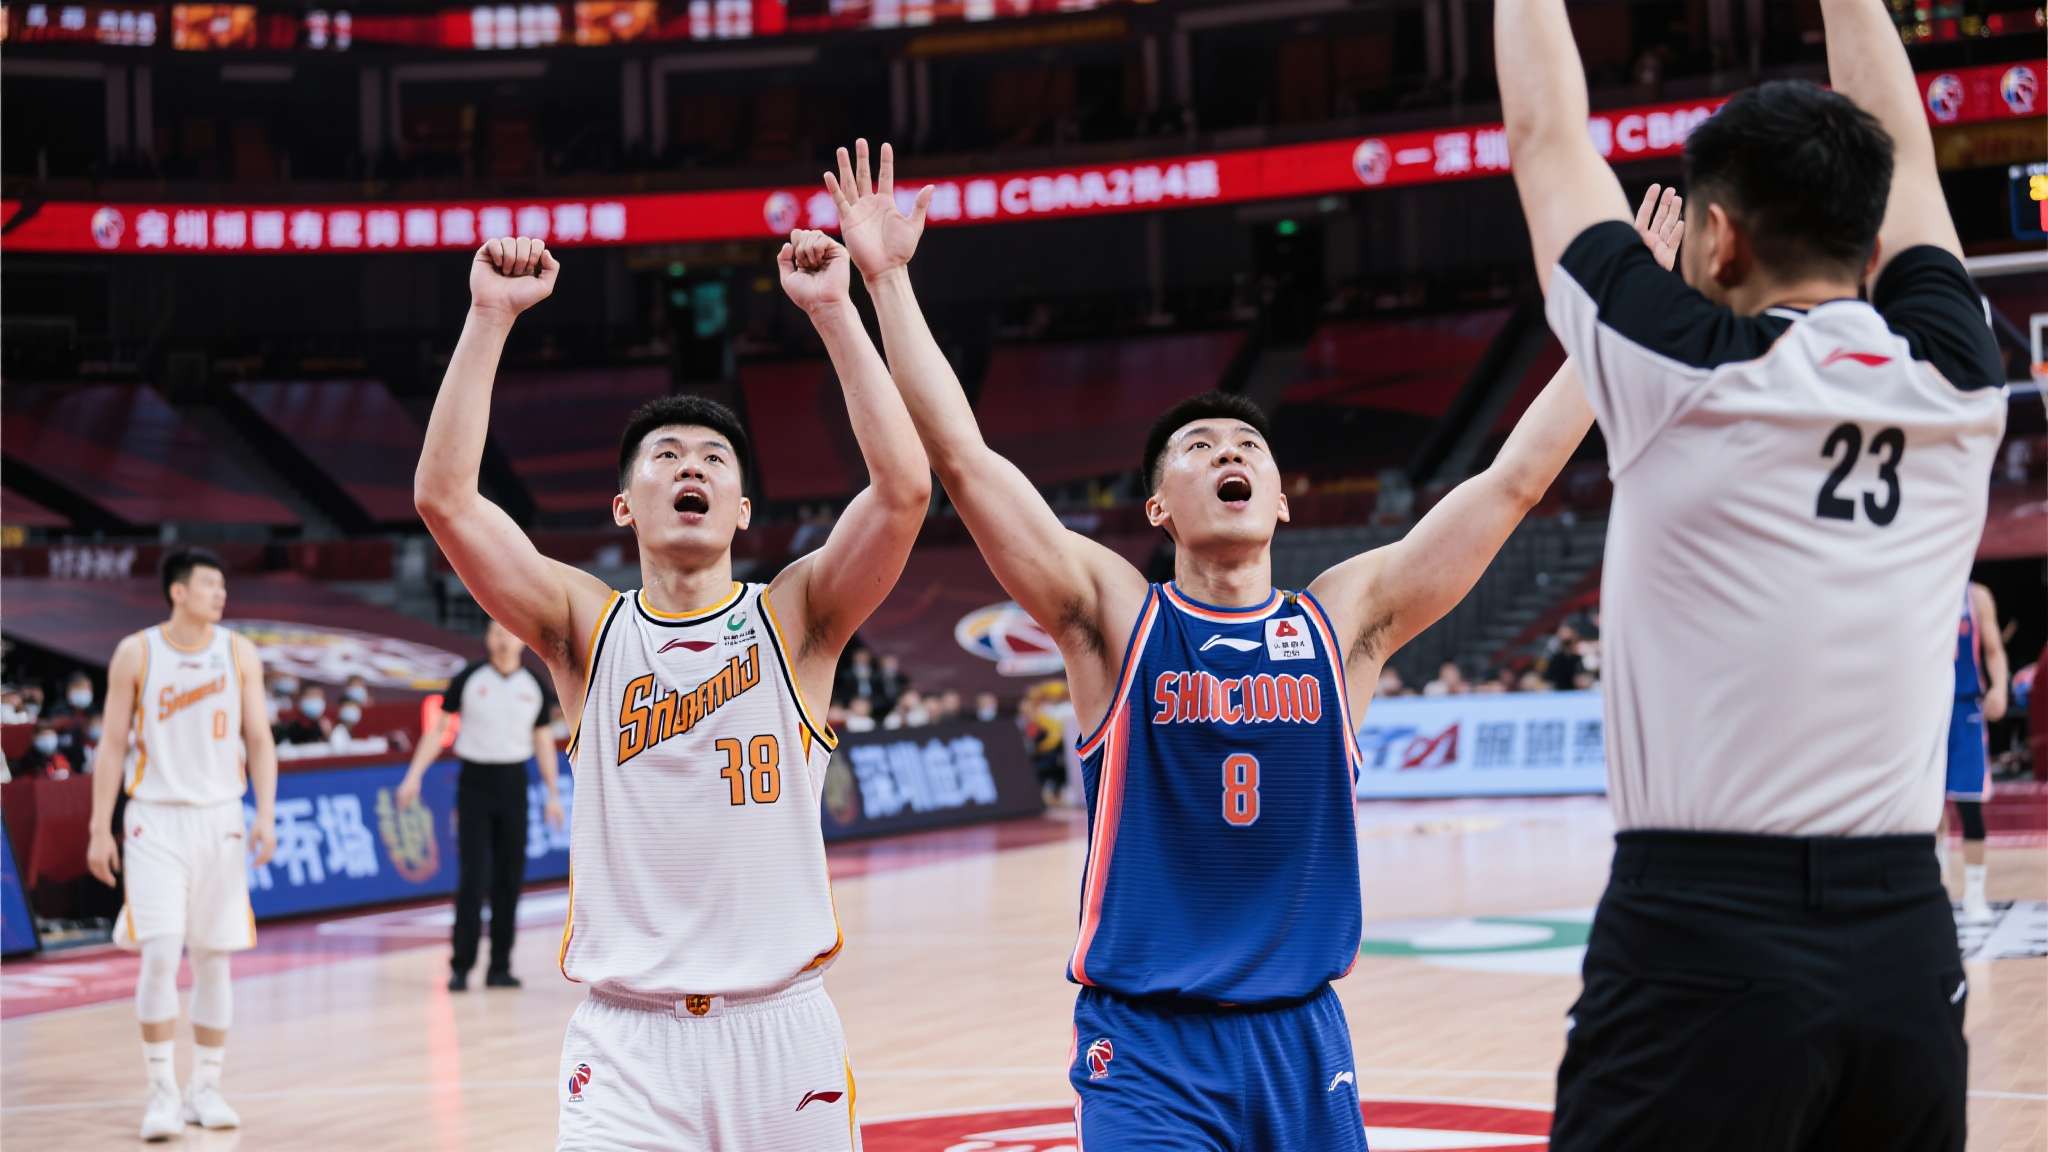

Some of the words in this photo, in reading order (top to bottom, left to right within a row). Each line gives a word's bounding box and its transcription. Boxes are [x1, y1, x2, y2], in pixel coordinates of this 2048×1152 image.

[1816, 422, 1906, 527] 23
[715, 734, 780, 805] 38
[1222, 753, 1260, 826] 8
